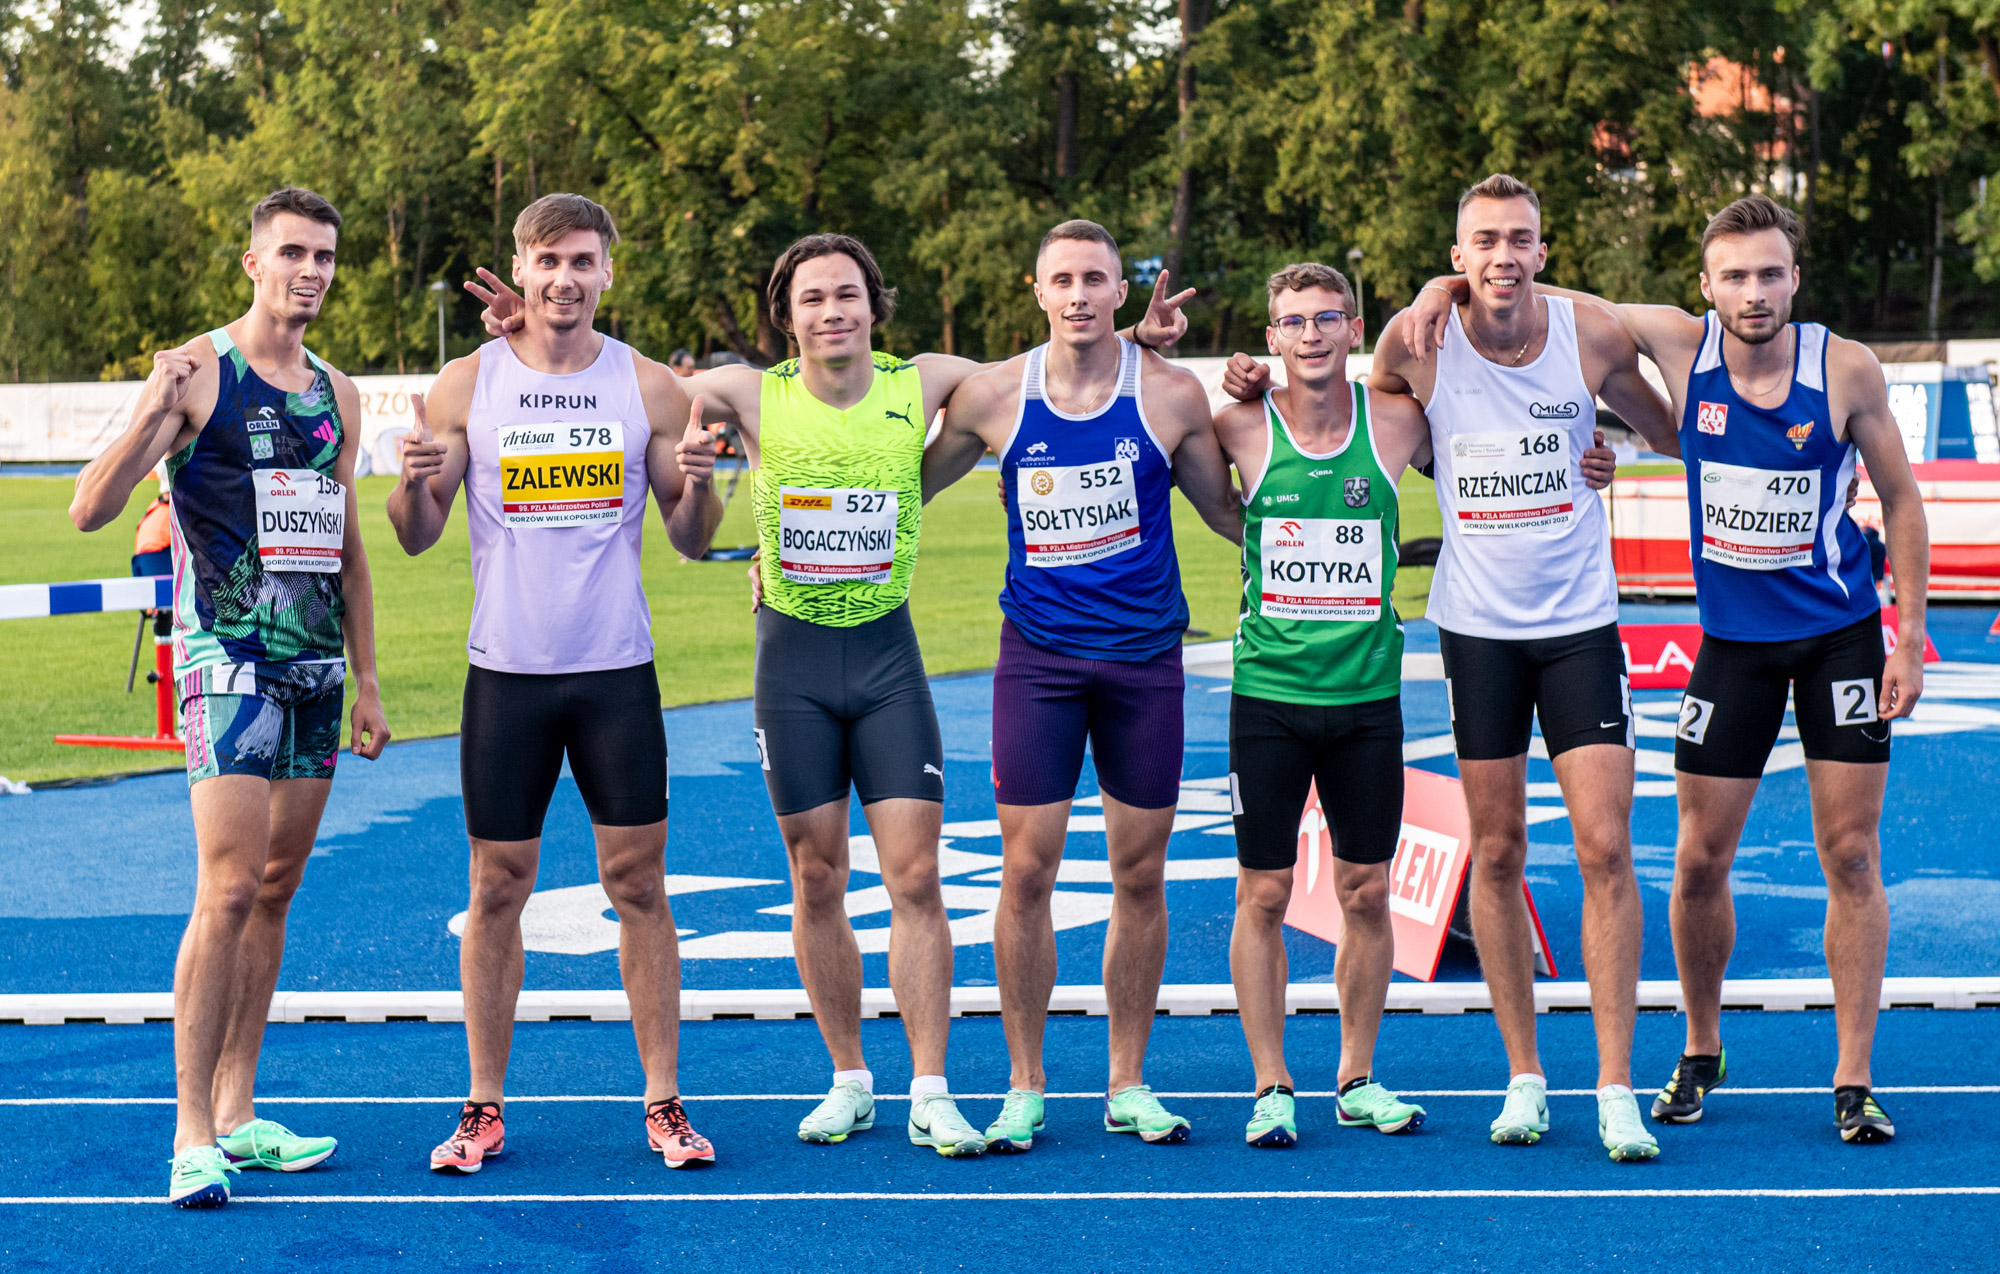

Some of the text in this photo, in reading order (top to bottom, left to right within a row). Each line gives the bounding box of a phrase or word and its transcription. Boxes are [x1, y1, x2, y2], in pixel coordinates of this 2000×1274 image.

[360, 384, 424, 415] RZÓ
[519, 393, 597, 410] KIPRUN
[248, 421, 278, 430] ORLEN
[502, 430, 555, 448] Artisan
[569, 427, 612, 447] 578
[1519, 433, 1560, 456] 168
[315, 475, 340, 495] 158
[506, 462, 620, 491] ZALEWSKI
[1080, 466, 1122, 489] 552
[1458, 468, 1568, 498] RZEŹNICZAK
[1766, 476, 1811, 495] 470
[270, 489, 297, 497] ORLEN
[789, 498, 825, 507] DHL
[1276, 493, 1300, 503] UMCS
[548, 502, 590, 511] Mistrzostwa
[591, 500, 610, 508] Polski
[846, 494, 887, 513] 527
[1499, 510, 1540, 519] Mistrzostwa
[1542, 507, 1560, 515] Polski
[262, 507, 342, 535] DUSZYŃSKI
[510, 515, 544, 523] GORZÓW
[545, 513, 600, 522] WIELKOPOLSKI
[1025, 499, 1133, 531] SOŁTYSIAK
[1464, 522, 1495, 530] GORZÓW
[1497, 519, 1551, 529] WIELKOPOLSKI
[1705, 504, 1814, 533] PAŹDZIERZ
[783, 526, 891, 552] BOGACZYŃSKI
[1050, 544, 1066, 552] PZLA
[1066, 540, 1106, 551] Mistrzostwa
[1107, 532, 1126, 543] Polski
[1335, 525, 1364, 544] 88
[1032, 537, 1135, 562] GORZÓW WIELKOPOLSKI 2023
[1706, 547, 1734, 560] GORZÓW
[1735, 555, 1789, 565] WIELKOPOLSKI
[1723, 541, 1737, 549] PZLA
[1738, 546, 1780, 555] Mistrzostwa
[1781, 545, 1800, 553] Polski
[266, 558, 297, 566] GORZÓW
[821, 565, 861, 573] Mistrzostwa
[862, 564, 881, 572] Polski
[1270, 559, 1373, 584] KOTYRA
[785, 573, 816, 582] GORZÓW
[872, 573, 886, 581] 2023
[1266, 605, 1298, 614] GORZÓW
[1275, 595, 1285, 603] 99.
[1303, 597, 1345, 605] Mistrzostwa
[1346, 597, 1366, 605] Polski
[222, 661, 245, 692] 7
[1842, 684, 1869, 720] 2
[1680, 702, 1703, 738] 2
[1390, 837, 1448, 909] LEN
